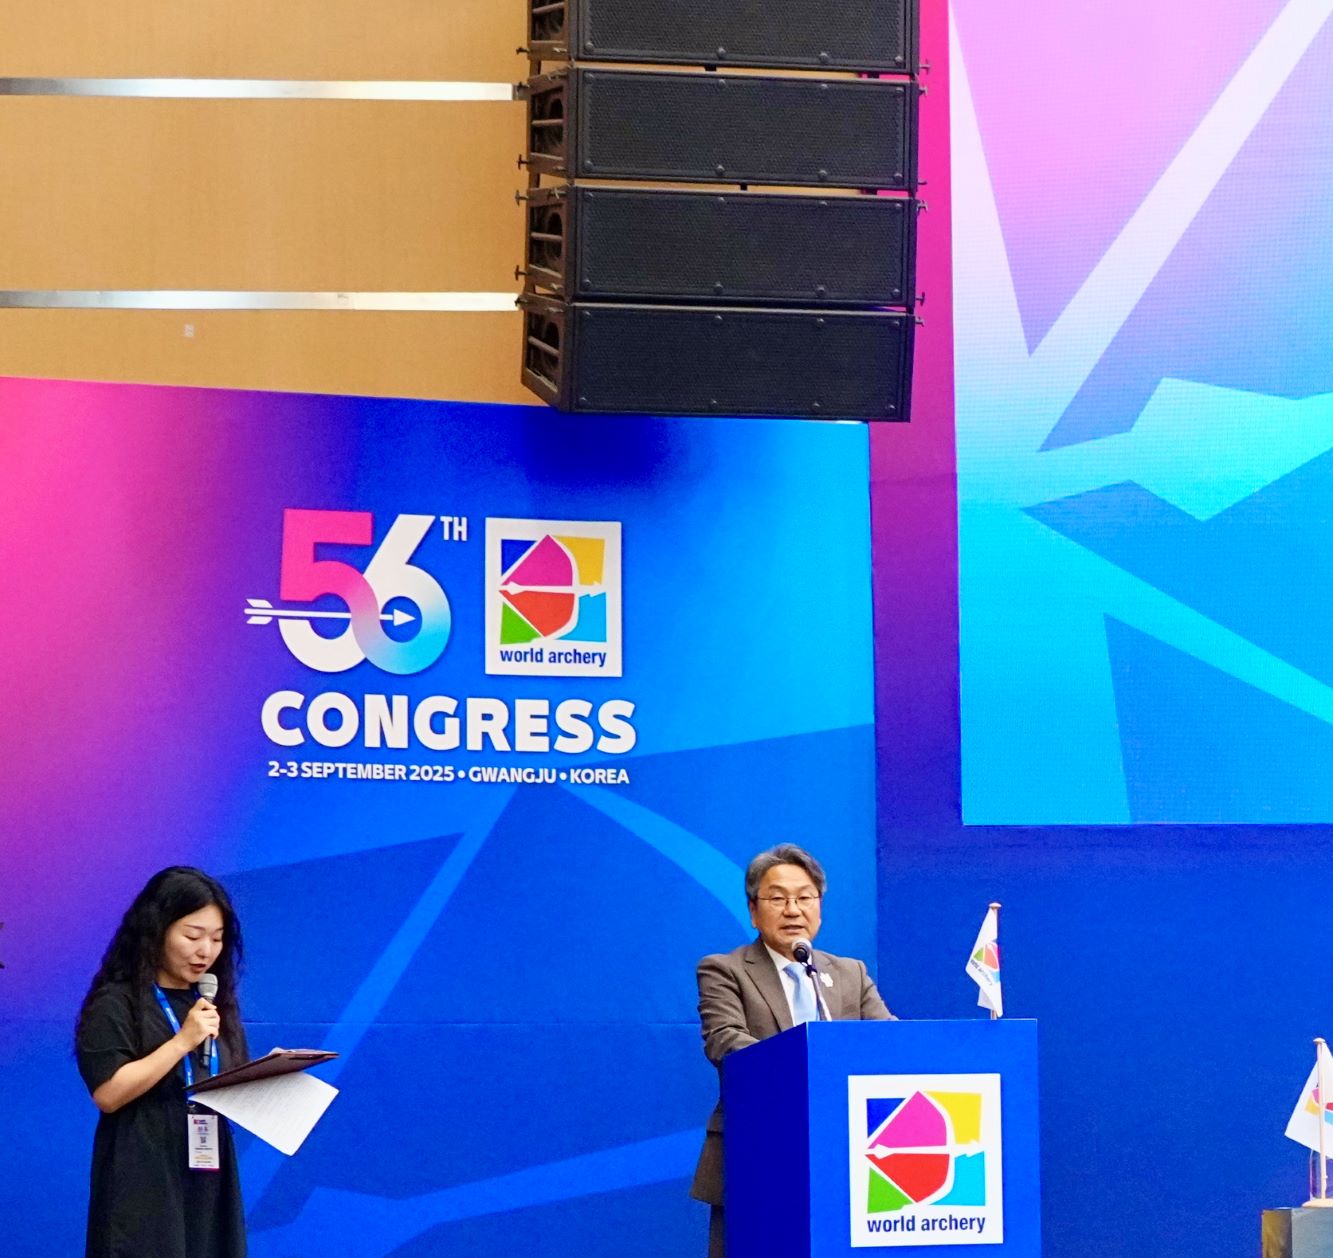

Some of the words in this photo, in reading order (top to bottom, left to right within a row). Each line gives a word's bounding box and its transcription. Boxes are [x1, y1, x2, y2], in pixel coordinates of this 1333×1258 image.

[499, 648, 544, 665] world
[547, 648, 607, 668] archery
[261, 689, 637, 754] CONGRESS
[267, 760, 299, 778] 2-3
[300, 762, 407, 781] SEPTEMBER
[409, 764, 455, 782] 2025
[468, 766, 557, 784] GWANGJU
[569, 768, 630, 785] KOREA
[867, 1214, 916, 1233] world
[920, 1214, 986, 1234] archery
